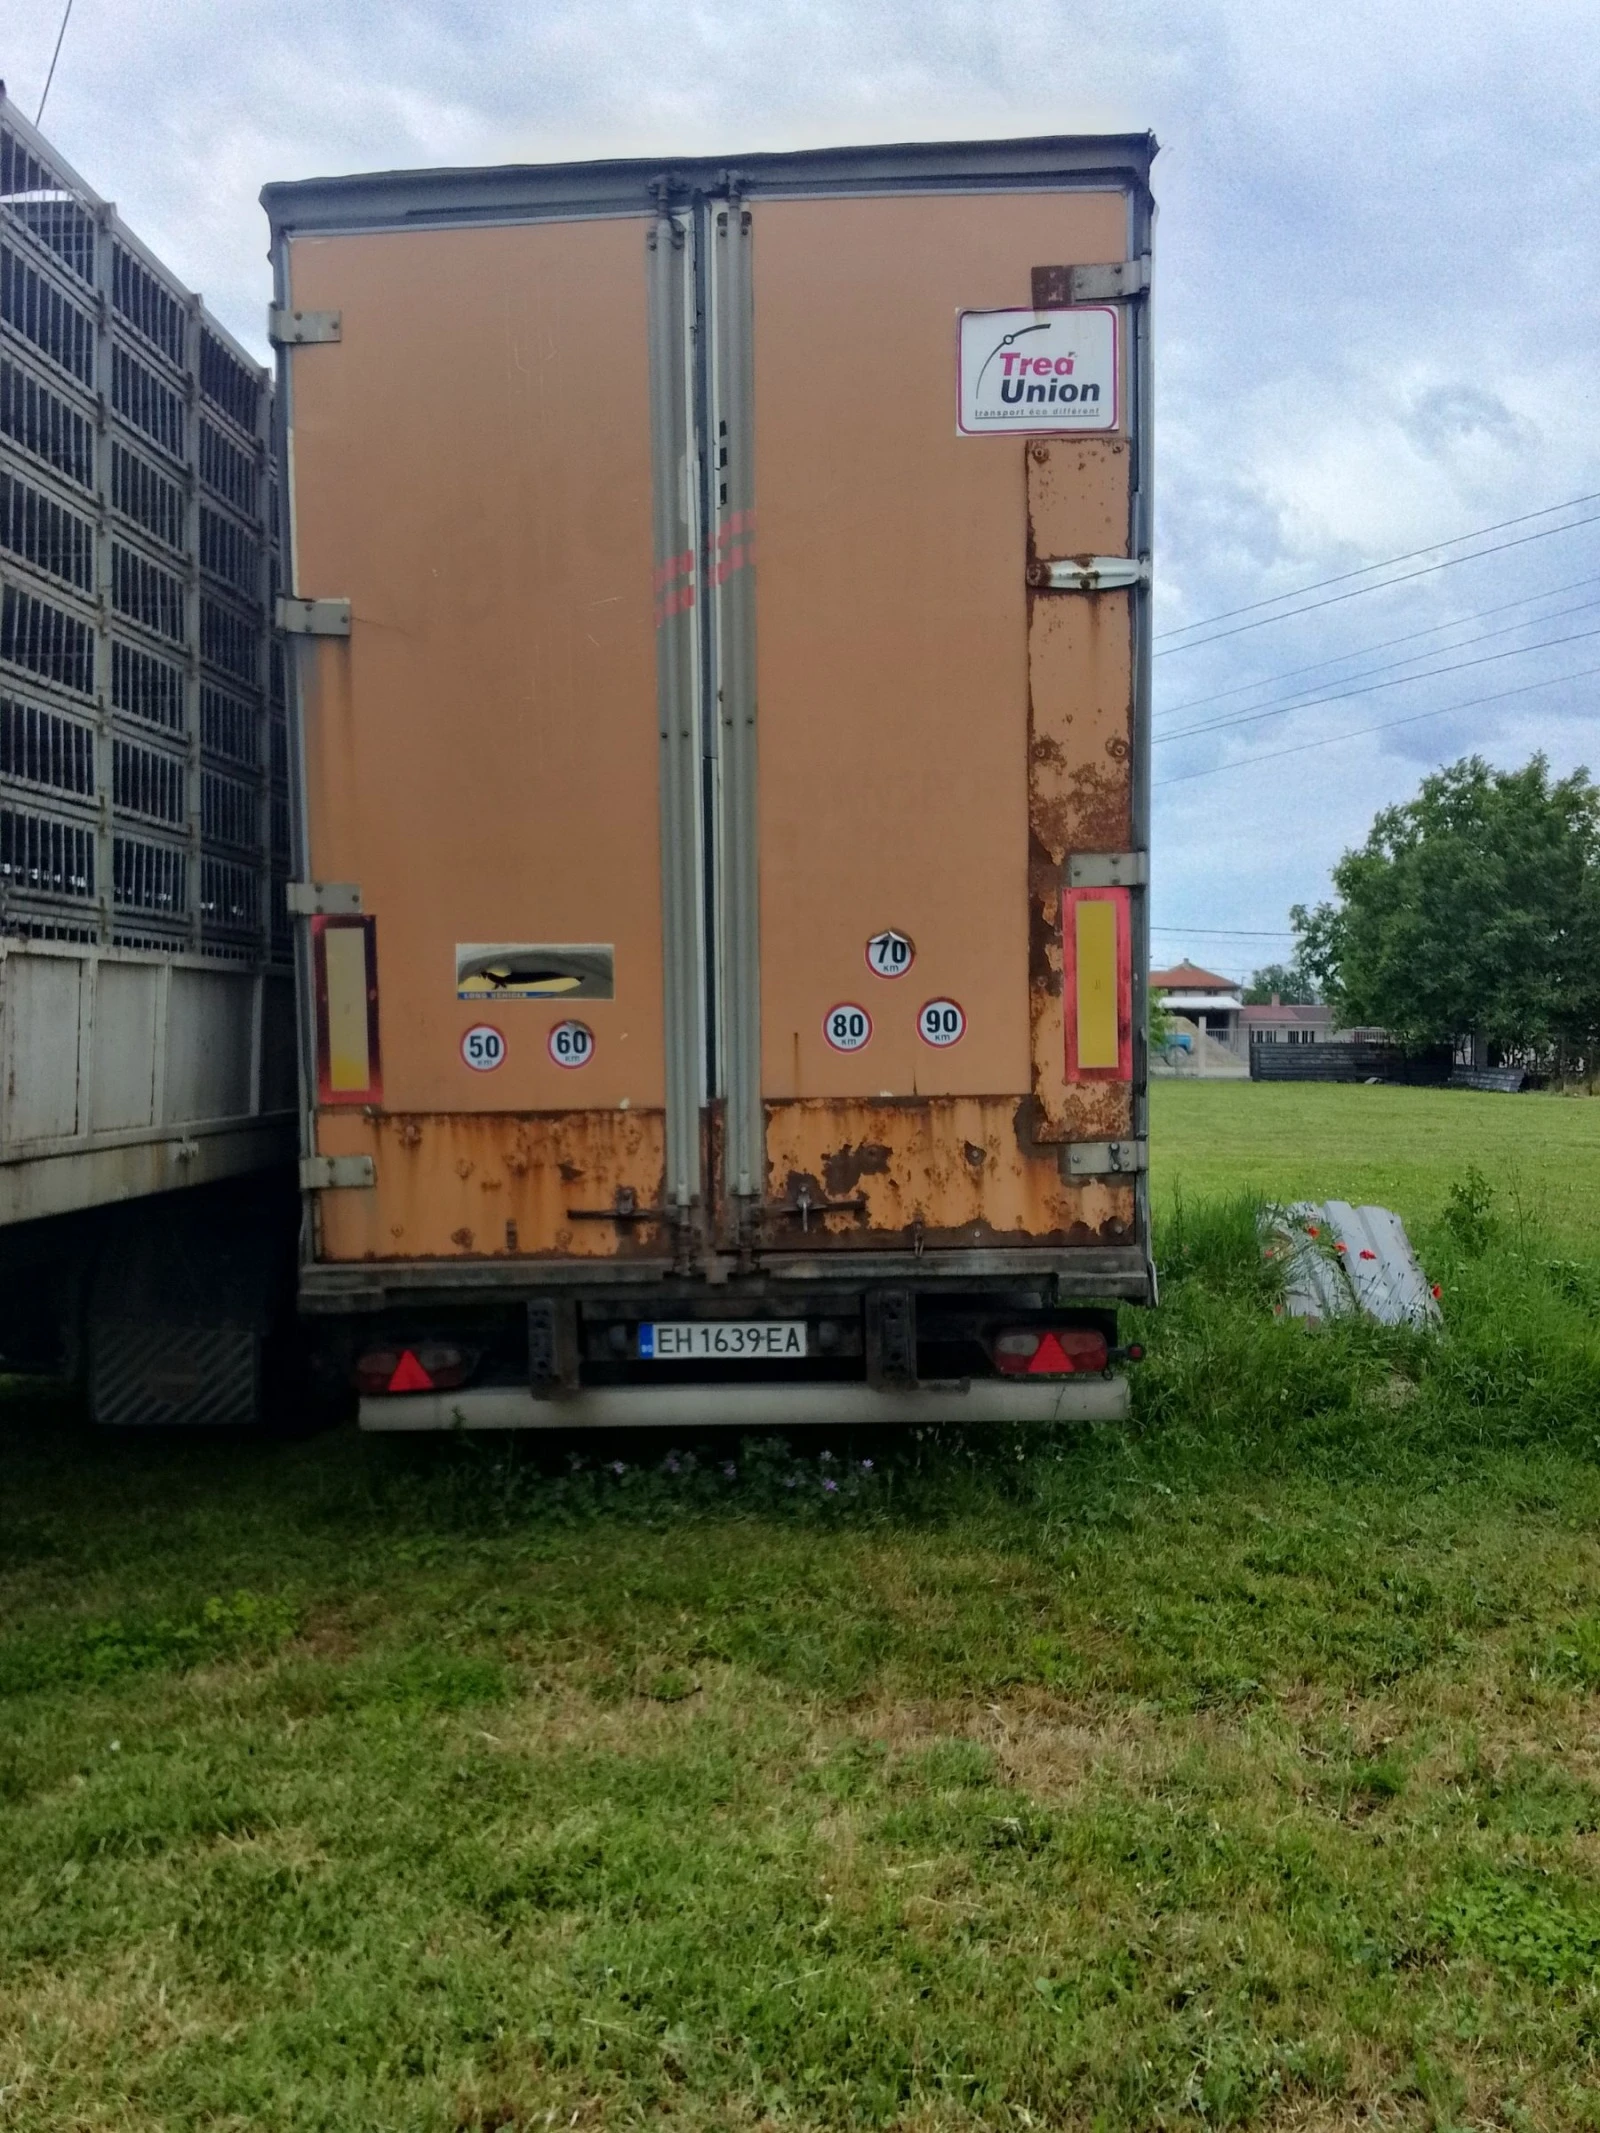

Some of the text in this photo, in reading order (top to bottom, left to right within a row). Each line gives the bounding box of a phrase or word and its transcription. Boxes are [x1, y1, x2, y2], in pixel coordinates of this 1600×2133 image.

[1001, 378, 1100, 403] Union
[975, 409, 1025, 418] transport
[876, 939, 907, 963] 70
[833, 1014, 864, 1037] 80
[926, 1009, 958, 1033] 90
[469, 1035, 500, 1058] 50
[557, 1030, 587, 1054] 60
